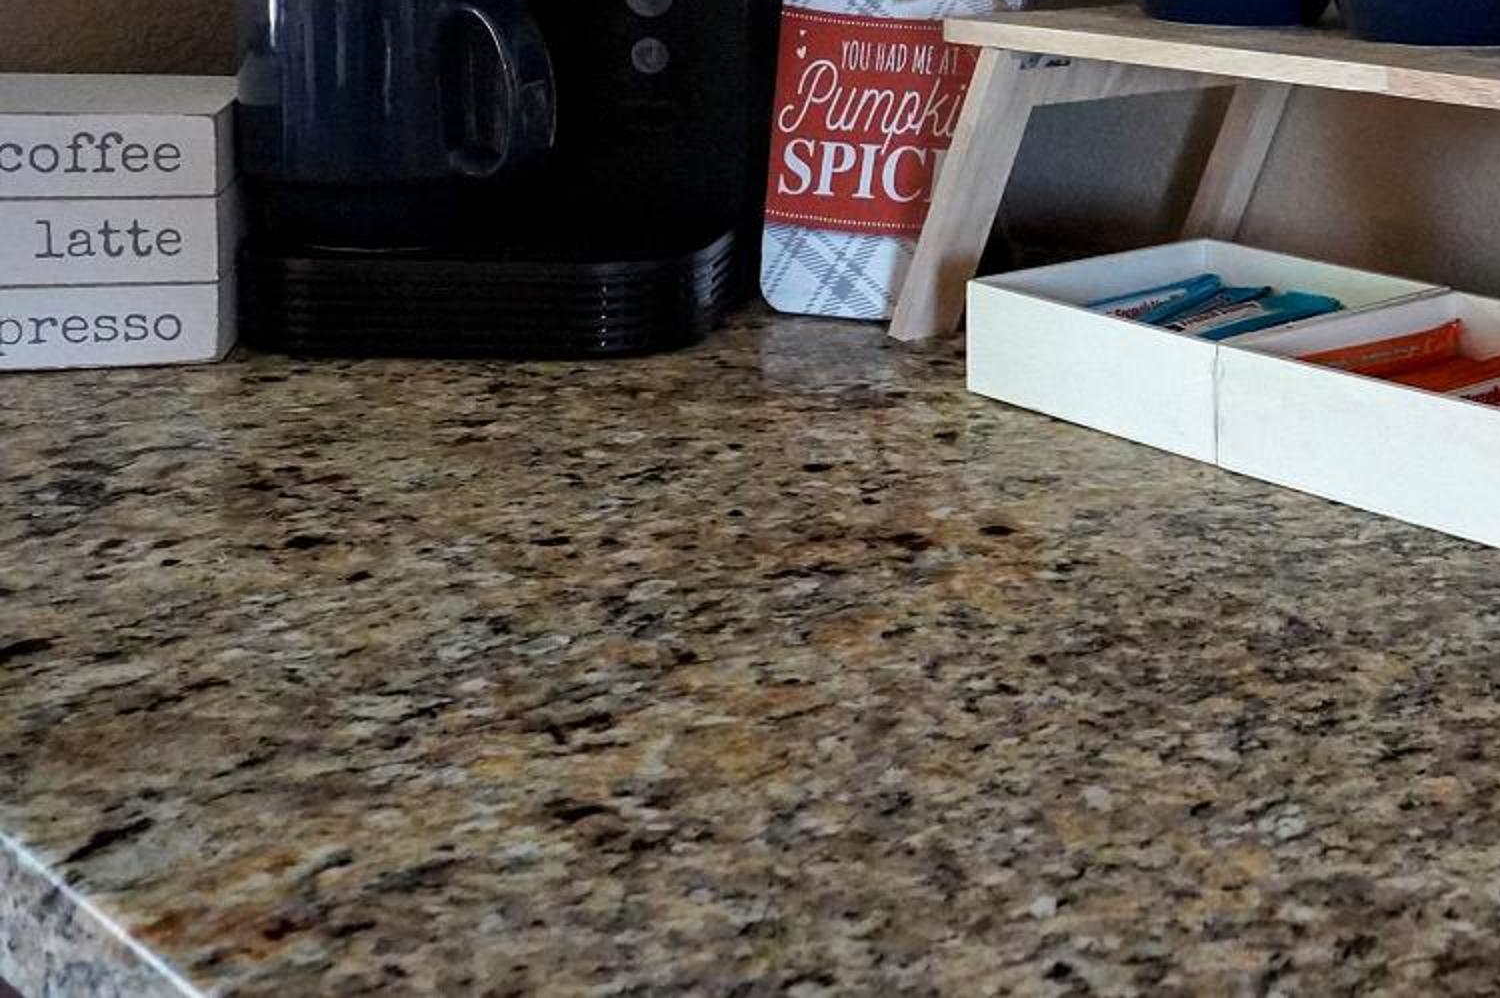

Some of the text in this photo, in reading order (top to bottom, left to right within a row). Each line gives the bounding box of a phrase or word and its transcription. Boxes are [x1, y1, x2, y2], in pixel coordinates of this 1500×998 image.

[841, 40, 960, 76] YOU HAD ME AT
[777, 59, 968, 154] Pumpki
[0, 131, 182, 173] coffee
[34, 218, 183, 259] latte
